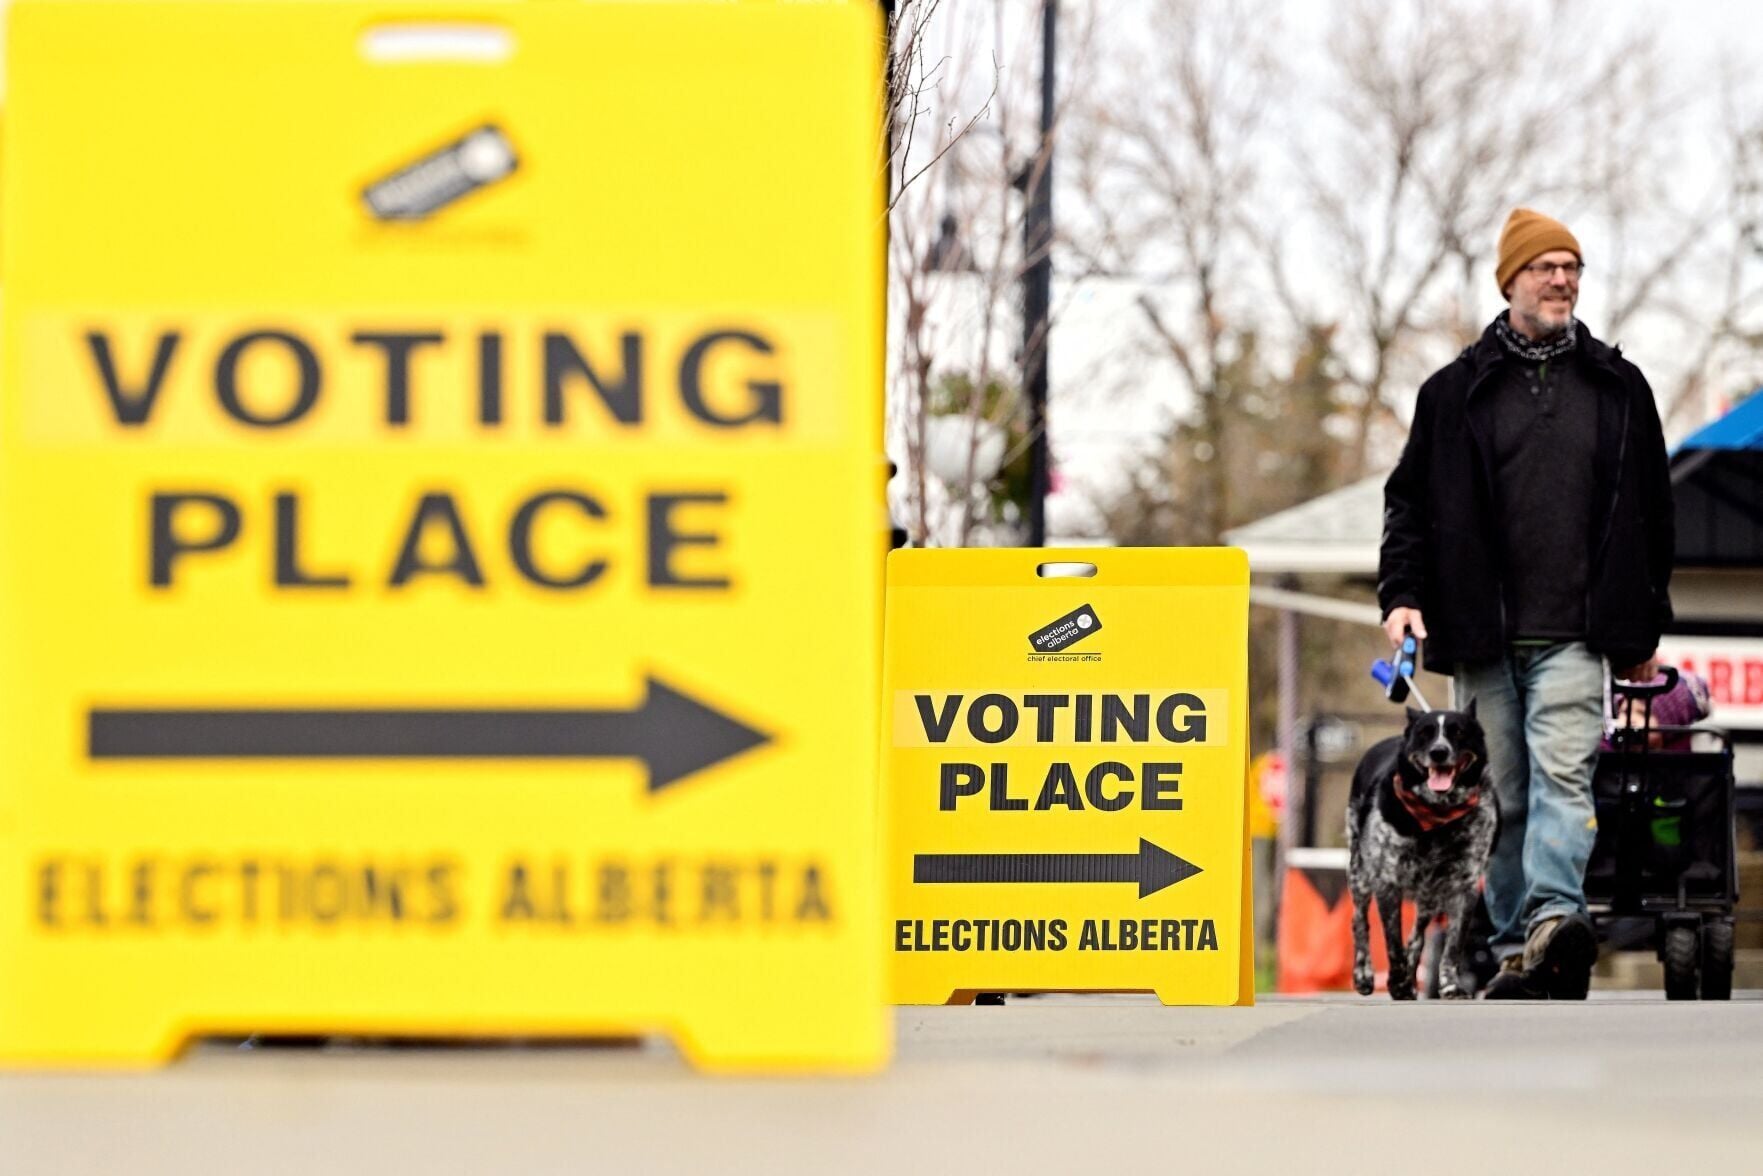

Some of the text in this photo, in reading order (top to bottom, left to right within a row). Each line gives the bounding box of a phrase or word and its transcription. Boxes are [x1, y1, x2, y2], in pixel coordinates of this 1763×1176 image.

[85, 328, 784, 430] VOTING
[148, 489, 732, 591] PLACE
[1036, 620, 1075, 645] elections
[1047, 627, 1079, 648] alberta
[914, 692, 1208, 744] VOTING
[939, 761, 1184, 812] PLACE
[38, 860, 833, 930] ELECTIONS ALBERTA
[894, 918, 1219, 952] ELECTIONS ALBERTA
